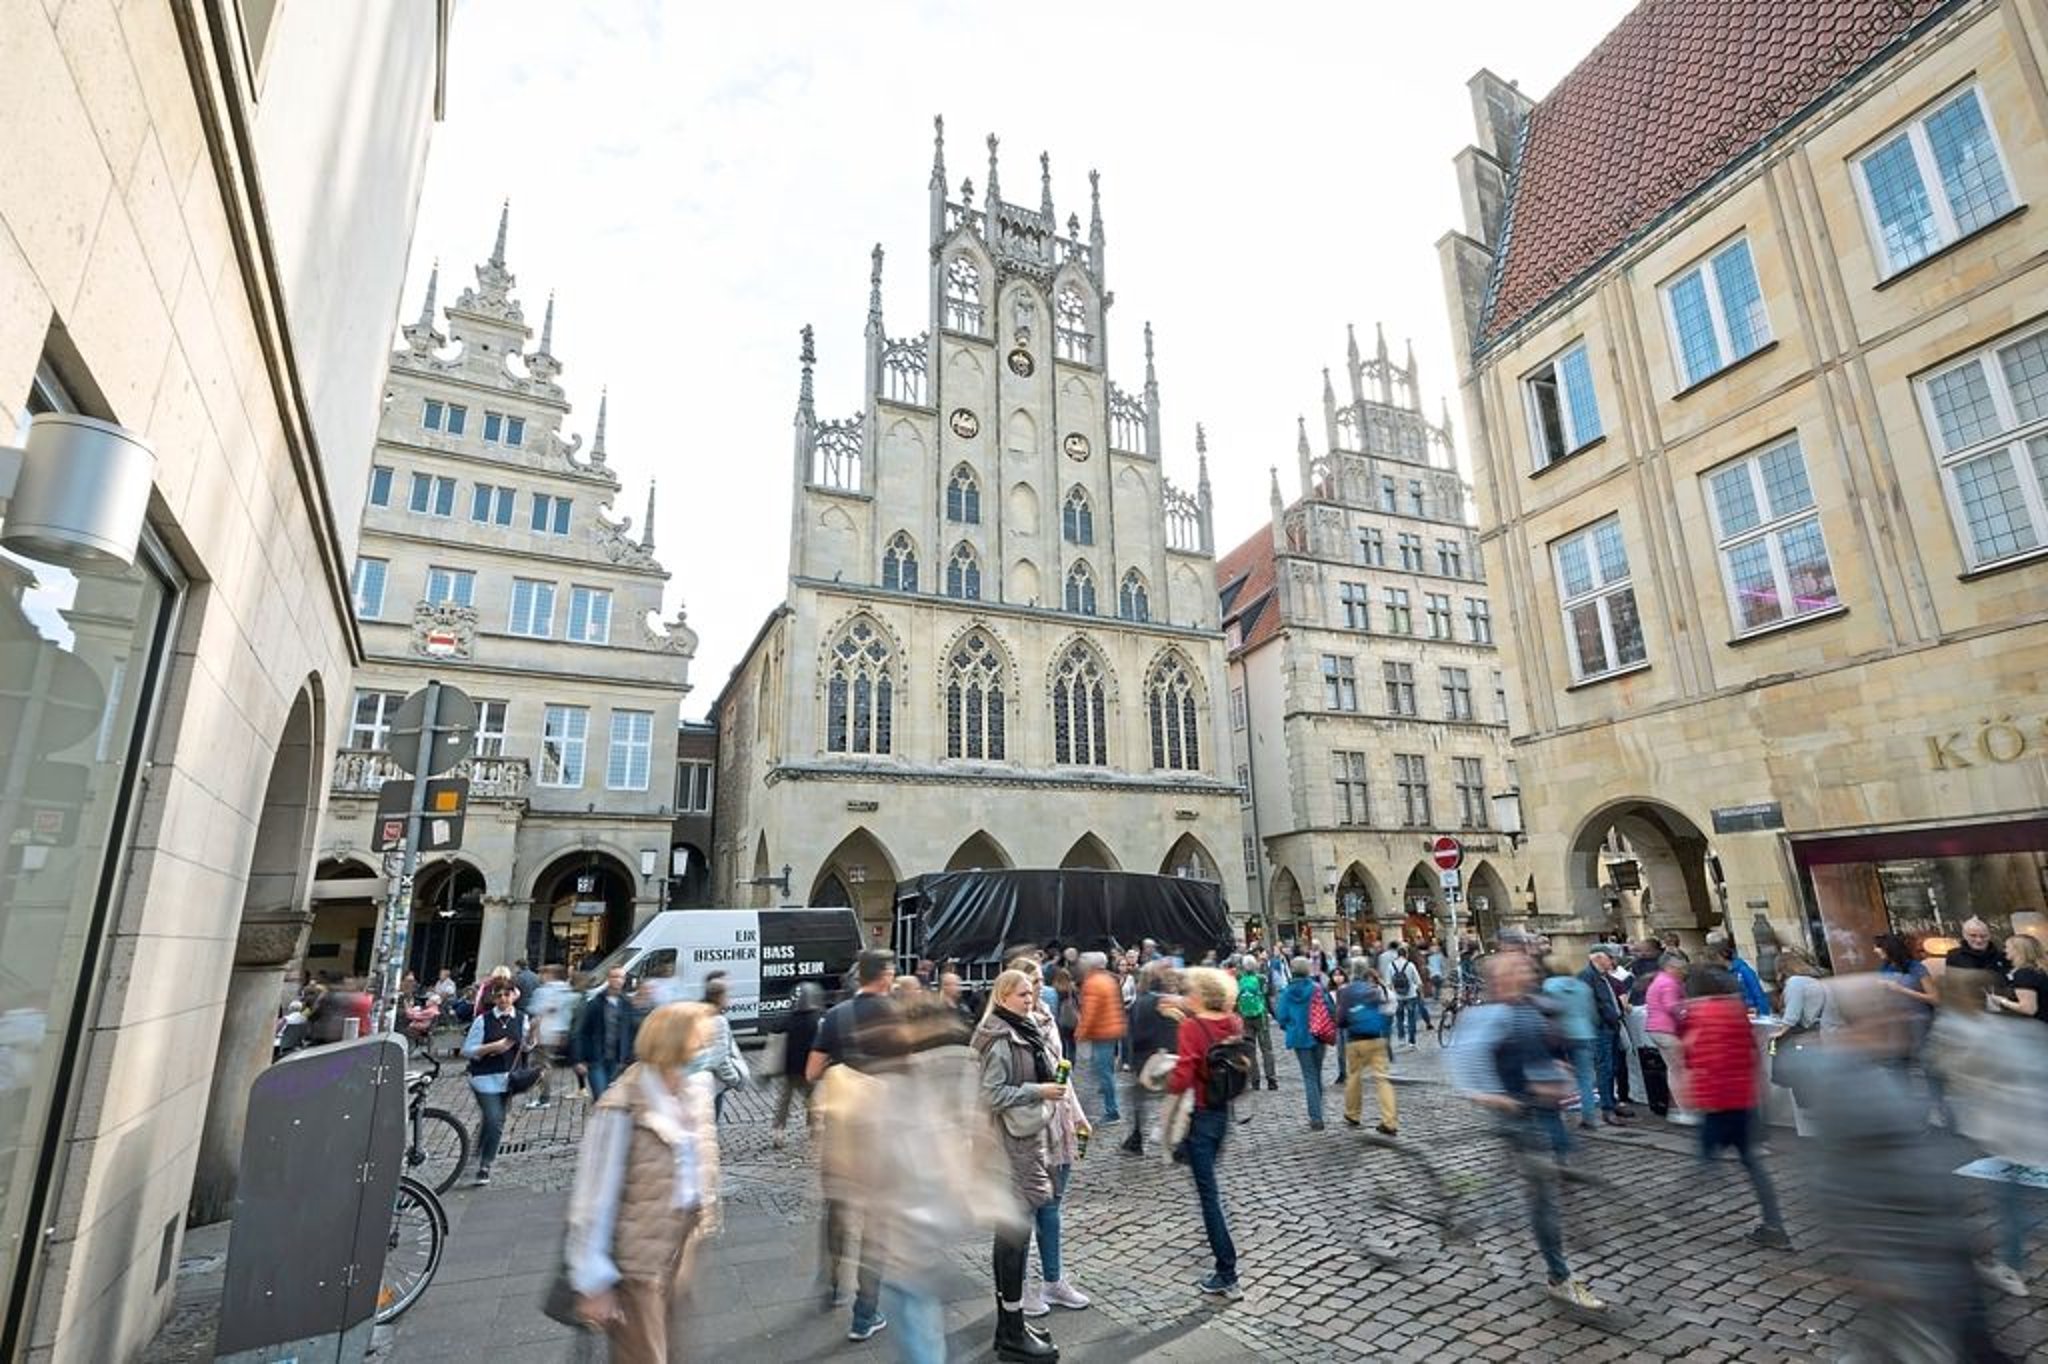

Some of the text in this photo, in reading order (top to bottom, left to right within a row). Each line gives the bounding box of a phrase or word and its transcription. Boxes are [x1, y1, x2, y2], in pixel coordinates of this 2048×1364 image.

[1925, 714, 2048, 771] KÖ
[735, 929, 757, 942] EIN
[693, 945, 795, 962] BISSCHEN BASS
[762, 961, 824, 977] MUSS SEIN
[759, 999, 792, 1011] SOUND
